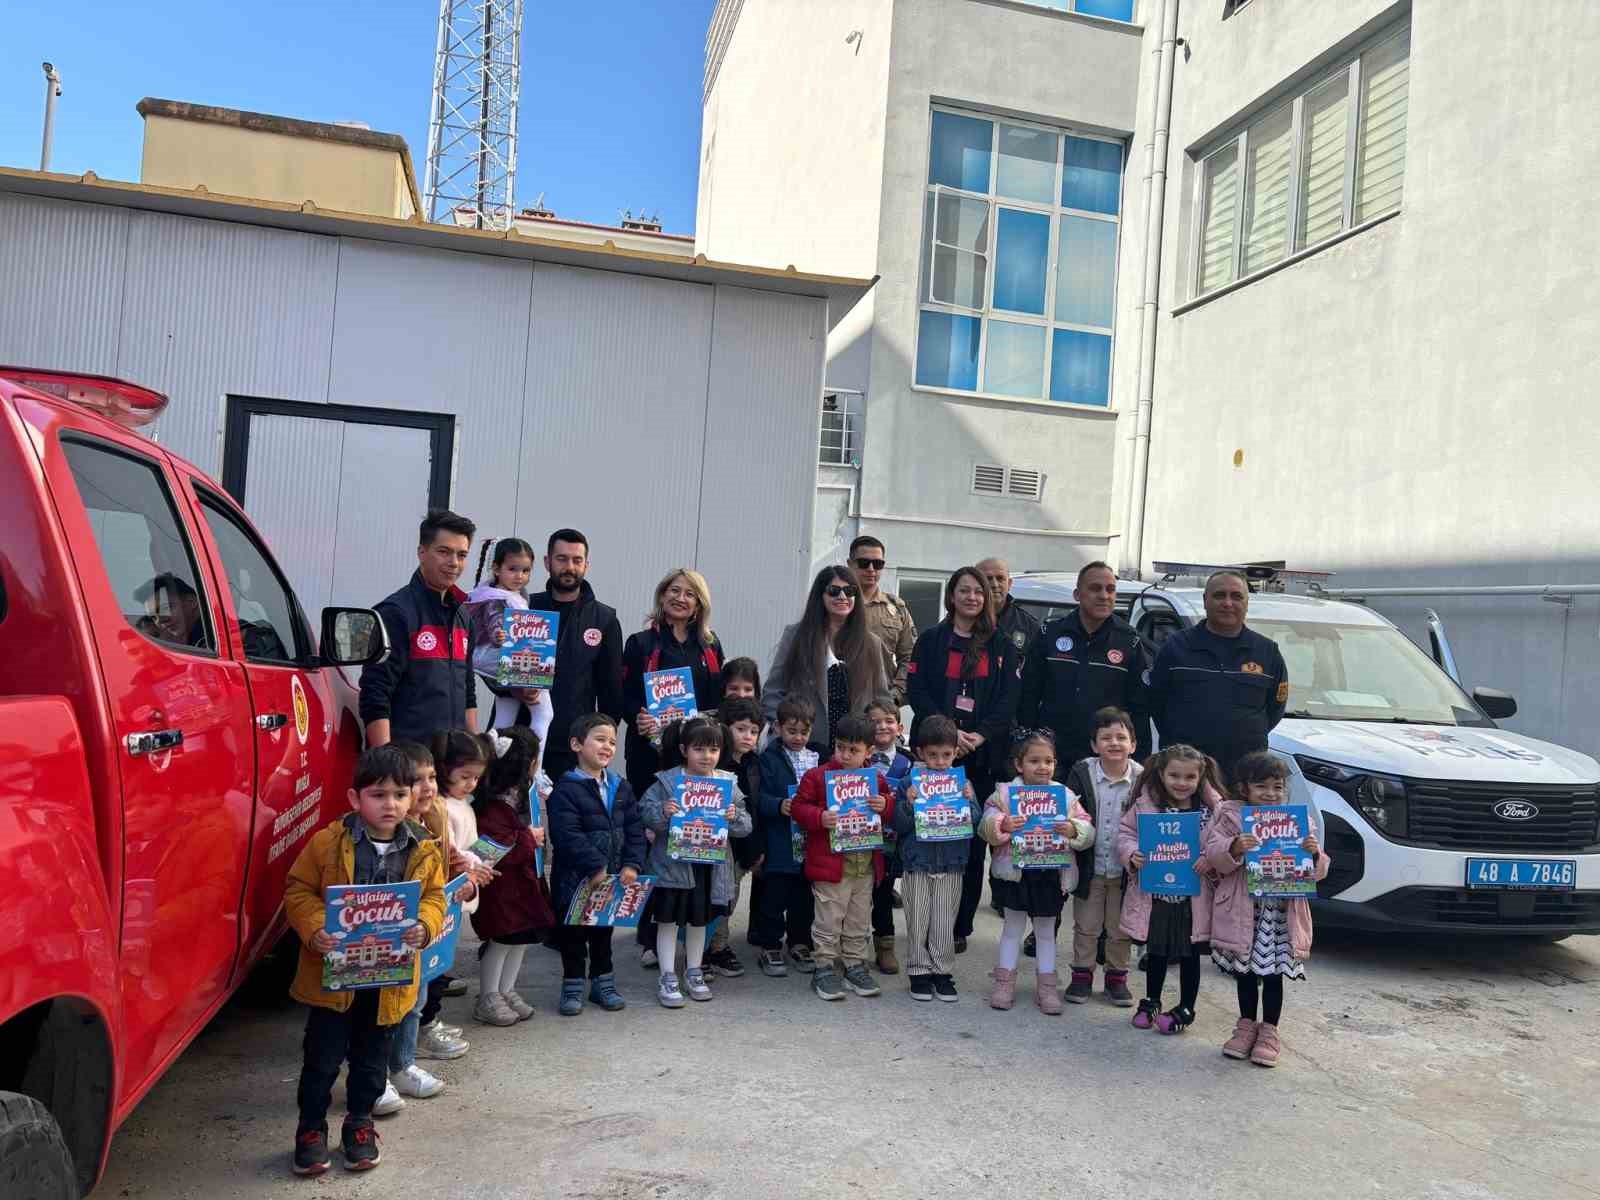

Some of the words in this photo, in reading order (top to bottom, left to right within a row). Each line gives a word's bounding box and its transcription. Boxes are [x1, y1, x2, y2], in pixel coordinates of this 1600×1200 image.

[510, 623, 550, 643] Çocuk
[652, 683, 686, 702] Çocuk
[833, 782, 870, 805] Çocuk
[919, 780, 958, 799] Çocuk
[681, 792, 722, 812] Çocuk
[1017, 800, 1057, 822] Çocuk
[1503, 803, 1530, 817] Ford
[1157, 821, 1181, 836] 112
[1250, 821, 1299, 845] Çocuk
[1479, 862, 1499, 882] 48
[1510, 863, 1519, 882] A
[1531, 863, 1572, 884] 7846
[339, 900, 406, 932] Çocuk
